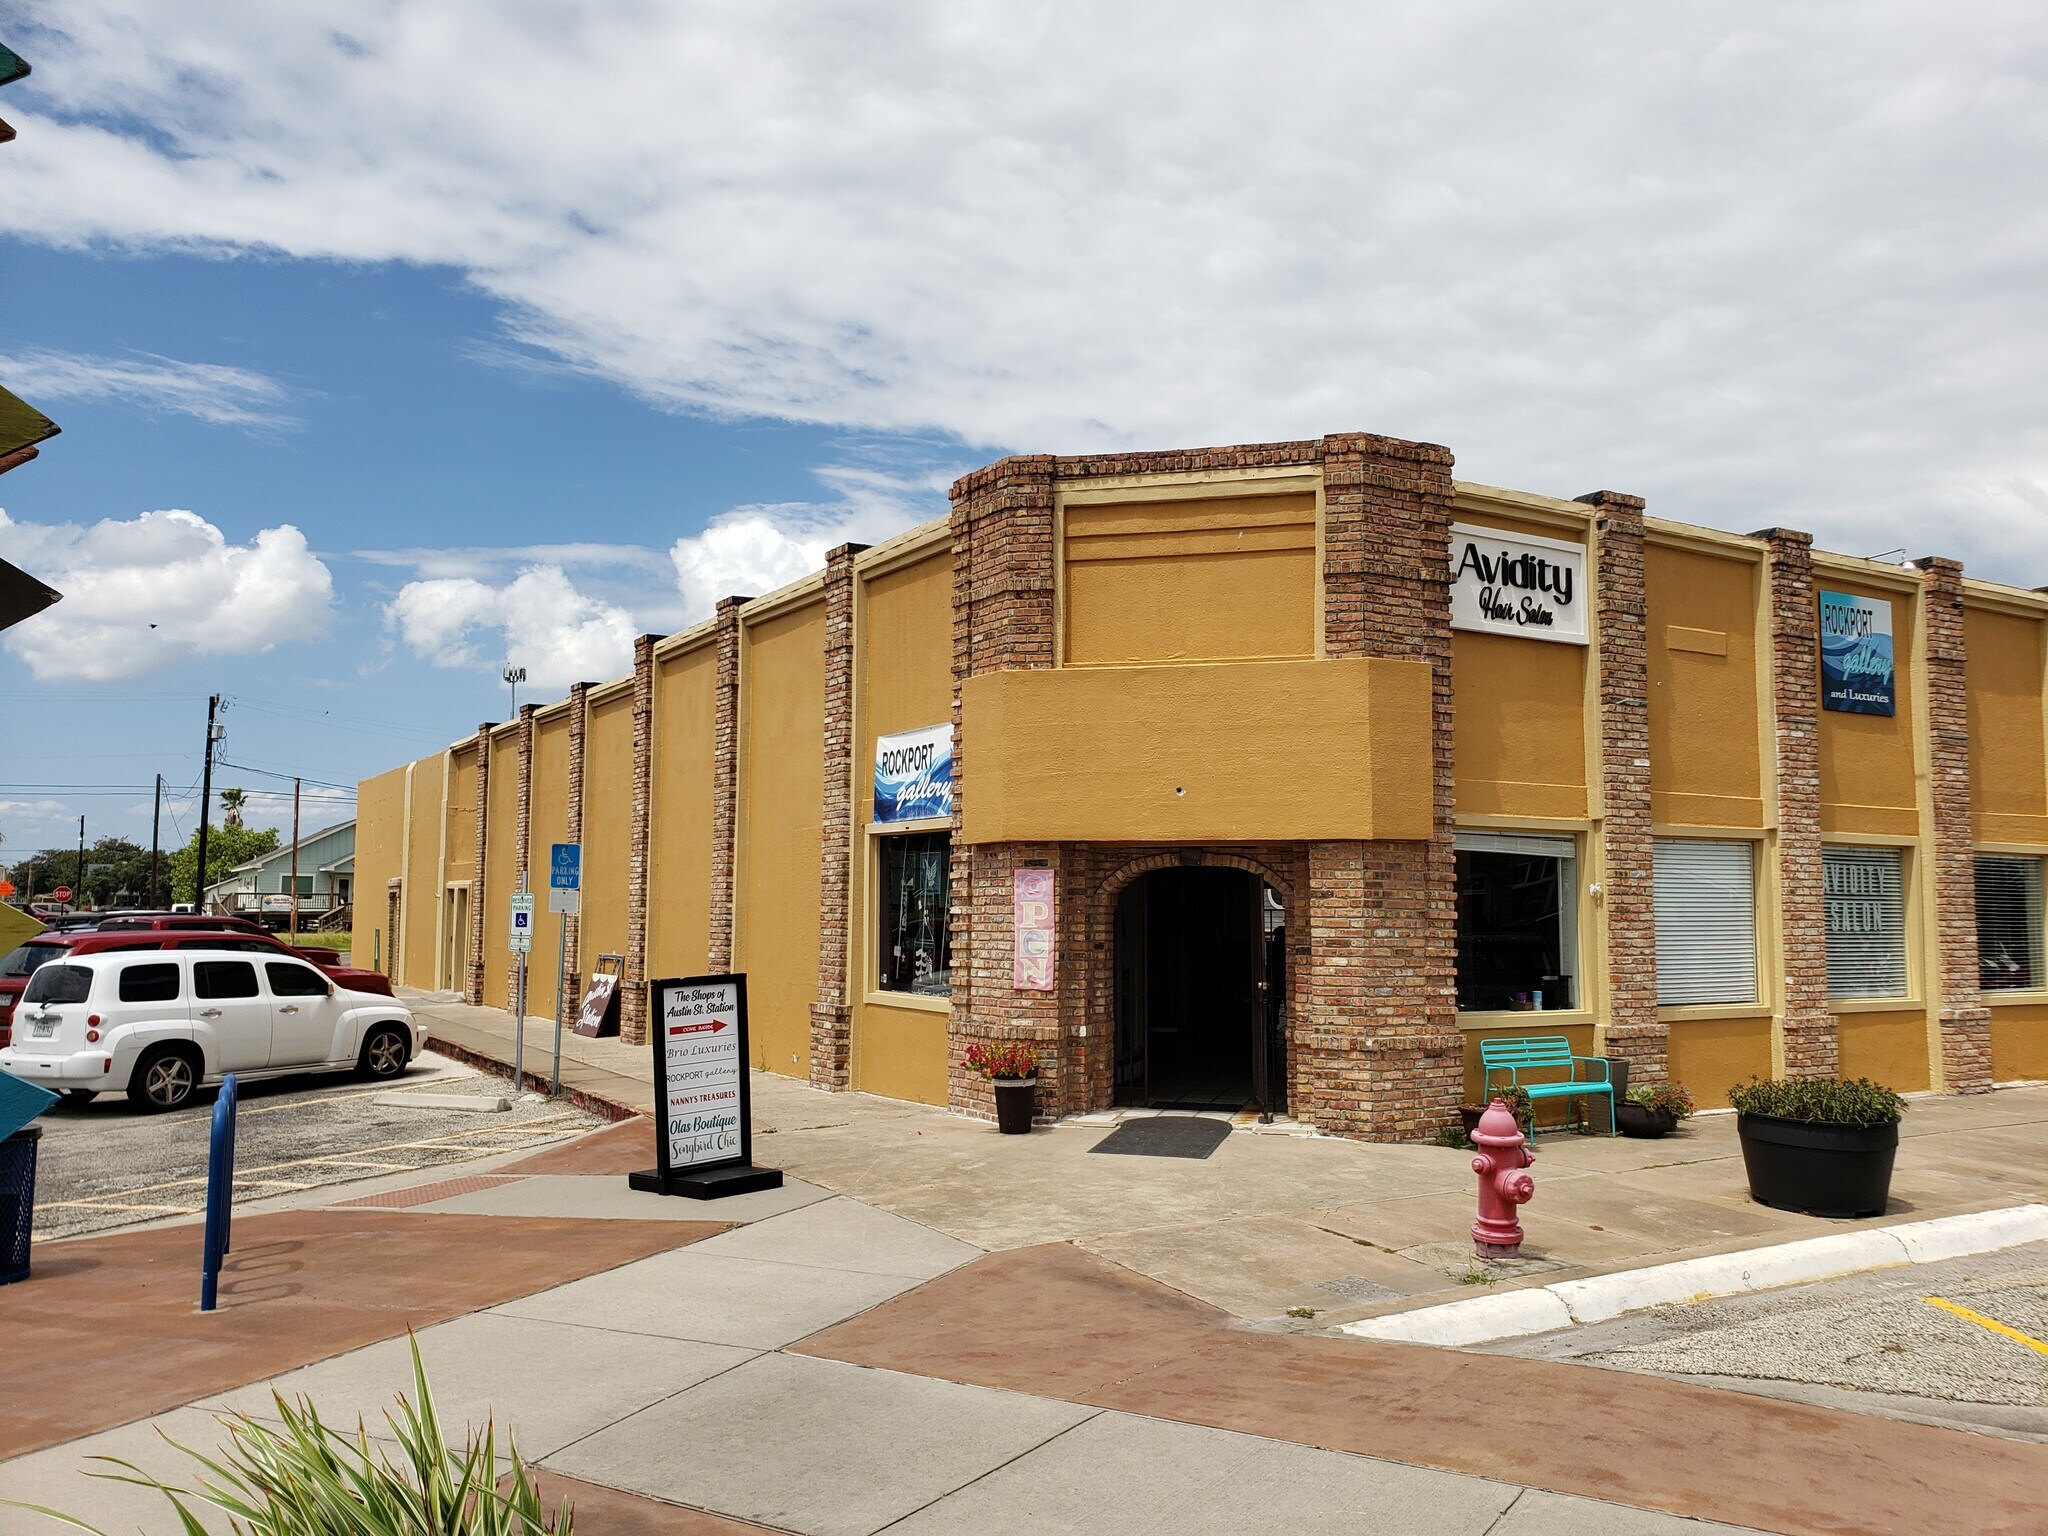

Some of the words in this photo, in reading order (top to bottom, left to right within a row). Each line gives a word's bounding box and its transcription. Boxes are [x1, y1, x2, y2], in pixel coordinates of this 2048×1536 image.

[1458, 543, 1573, 605] Avidity
[1479, 586, 1515, 620] Hair
[1516, 596, 1553, 626] Salon
[1825, 604, 1873, 638] ROCKPORT
[1843, 645, 1892, 685] gallery
[1830, 690, 1847, 699] and
[1849, 689, 1889, 703] Luxuries
[882, 743, 934, 777] ROCKPORT
[896, 774, 953, 811] gallery
[552, 866, 579, 875] PARKING
[556, 877, 573, 886] ONLY
[1831, 901, 1882, 931] SALON
[675, 991, 690, 1002] The
[691, 989, 716, 1003] Shops
[717, 989, 726, 1001] of
[667, 1006, 692, 1018] Austin
[693, 1004, 704, 1015] St.
[706, 1002, 735, 1014] Station
[667, 1047, 689, 1058] Brio
[691, 1042, 736, 1055] Luxuries
[667, 1070, 704, 1083] ROCKPORT
[705, 1067, 738, 1079] gallery
[670, 1096, 698, 1106] NANNY'S
[700, 1090, 736, 1102] TREASURES
[670, 1119, 691, 1135] Olas
[693, 1114, 736, 1132] Boutique
[672, 1134, 713, 1162] Songbird
[717, 1133, 736, 1150] Chic
